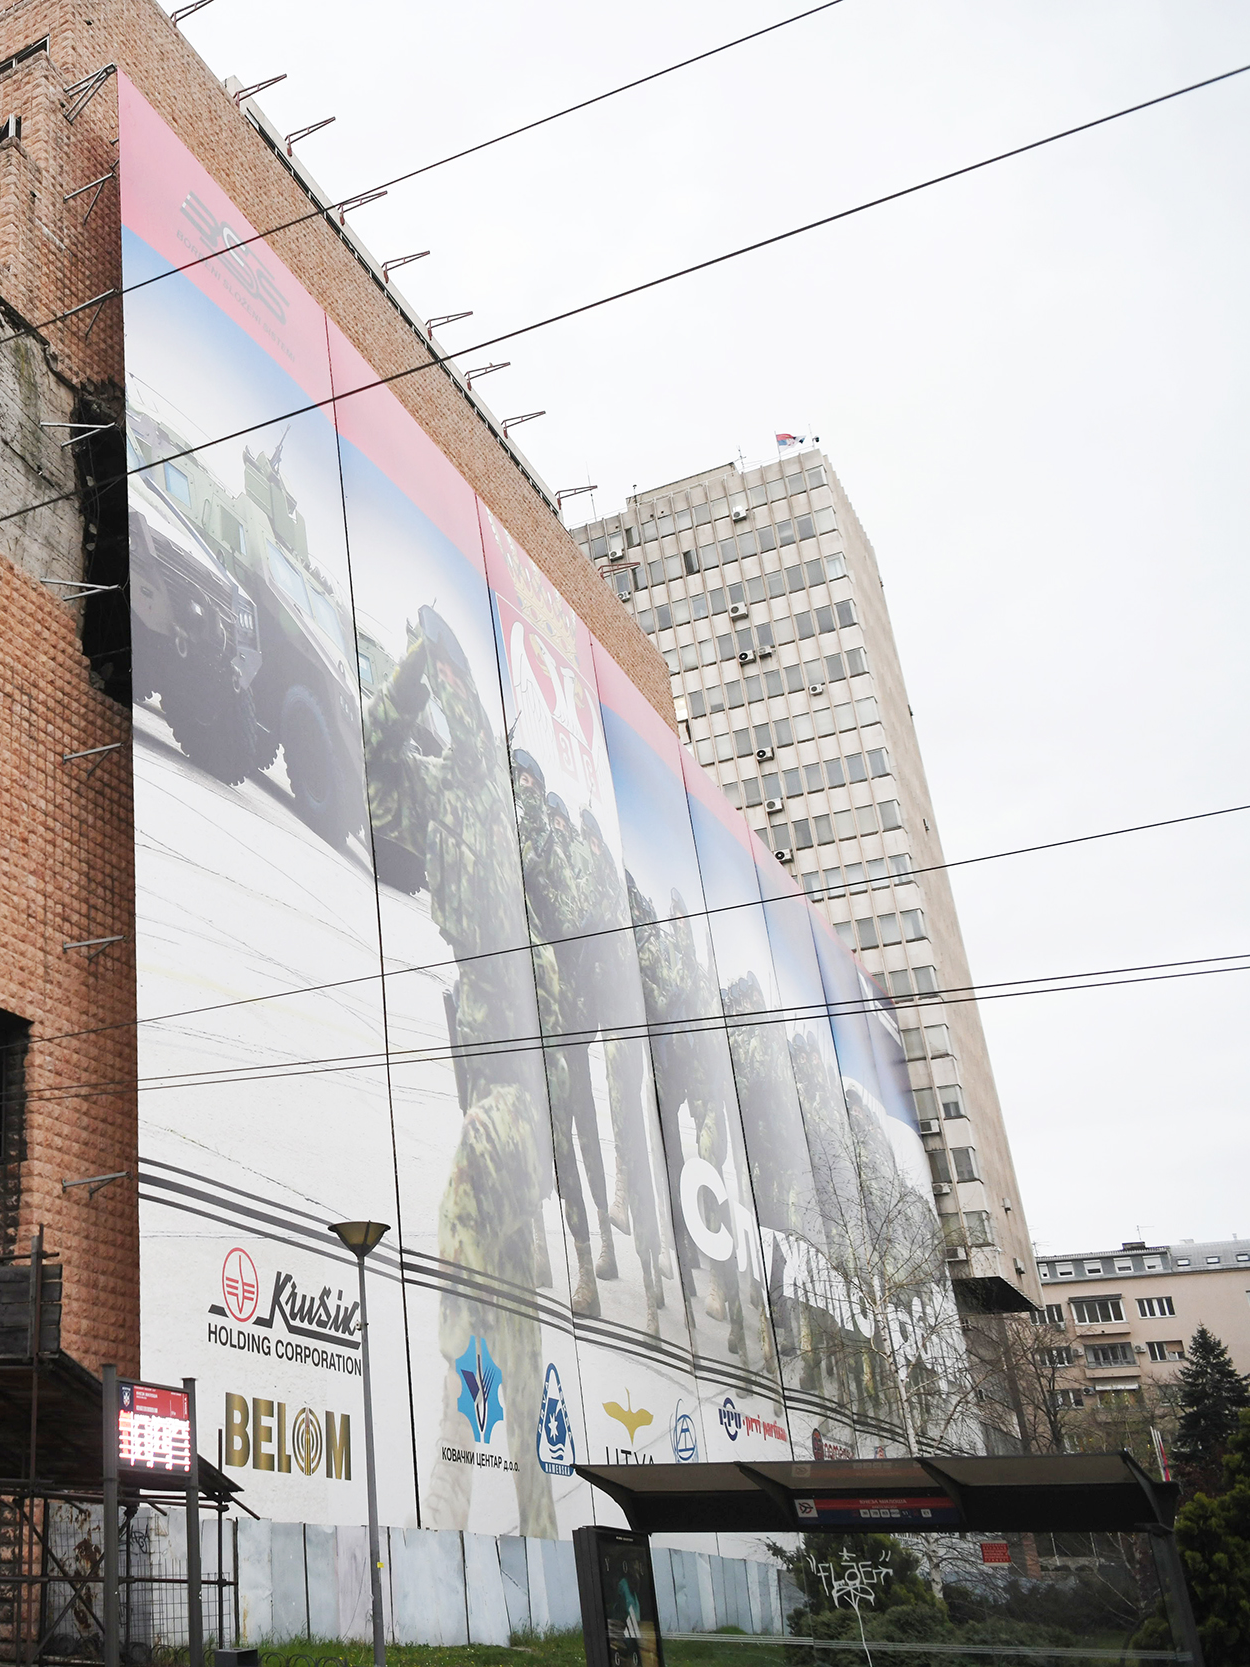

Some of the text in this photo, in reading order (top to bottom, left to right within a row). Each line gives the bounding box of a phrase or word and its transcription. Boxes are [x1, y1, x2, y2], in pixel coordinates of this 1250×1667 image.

[175, 228, 222, 282] BORBENI
[263, 320, 296, 363] SISTEMI
[207, 1322, 363, 1377] HOLDING CORPORATION
[745, 1414, 762, 1437] prvi
[442, 1446, 475, 1465] КОВАЧКИ
[476, 1452, 503, 1471] ЦЕНТАР
